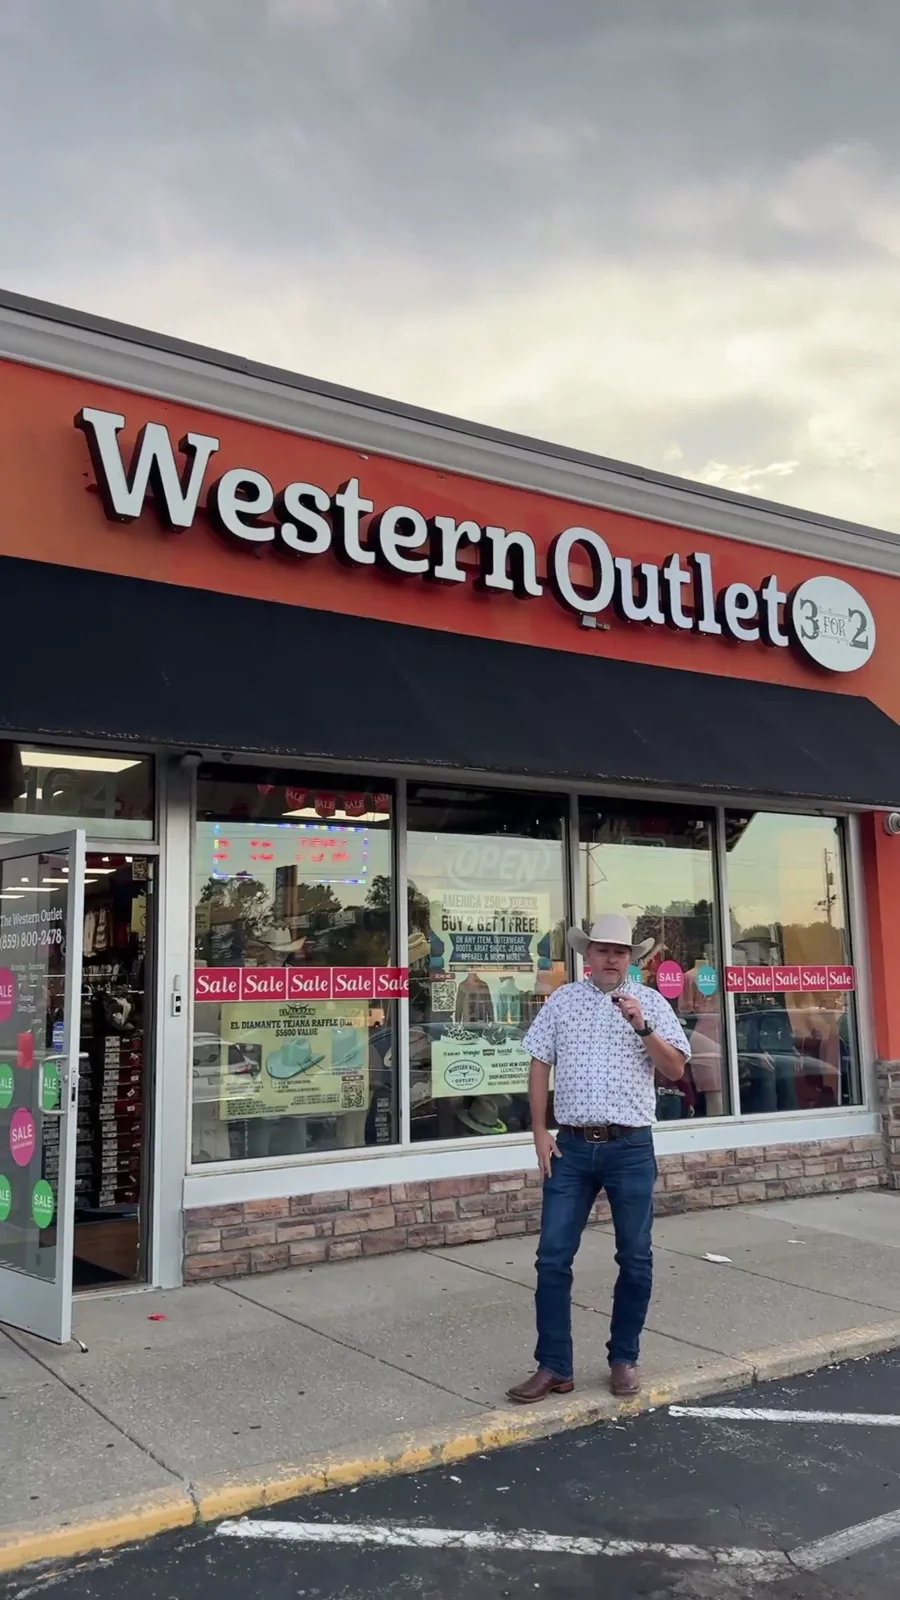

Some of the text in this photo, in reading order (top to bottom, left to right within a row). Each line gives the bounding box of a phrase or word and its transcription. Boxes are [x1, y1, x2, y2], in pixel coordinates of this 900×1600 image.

[81, 407, 789, 647] Western Outlet
[800, 598, 869, 650] 3 FOR 2
[315, 799, 336, 809] SALE
[344, 800, 364, 809] SALE
[454, 844, 542, 884] OPEN
[442, 893, 480, 908] AMERICA
[0, 907, 63, 927] The Western Outlet
[442, 915, 539, 933] BUY 2 GET 1 FREE!
[0, 928, 62, 950] (859) 800-2478
[455, 936, 463, 944] ON
[464, 936, 475, 944] ANY
[474, 944, 489, 952] ARIAT
[244, 975, 284, 993] Sale
[290, 974, 328, 993] Sale
[335, 974, 371, 992] Sale
[377, 974, 409, 991] Sale
[627, 974, 641, 983] ALE
[659, 972, 682, 982] SALE
[698, 974, 716, 983] SALE
[747, 972, 771, 986] Sale
[775, 972, 799, 986] Sale
[802, 971, 825, 985] Sale
[829, 971, 851, 985] Sale
[0, 984, 12, 998] ALE
[196, 975, 237, 994] Sale
[230, 1021, 239, 1029] EL
[241, 1020, 281, 1029] DIAMANTE
[283, 1019, 310, 1028] TEJANA
[311, 1018, 338, 1027] RAFFLE
[297, 1028, 318, 1036] VALUE
[0, 1077, 12, 1086] ALE
[43, 1078, 57, 1089] ALE
[12, 1123, 33, 1142] SALE
[0, 1190, 10, 1201] ALE
[34, 1194, 52, 1207] SALE
